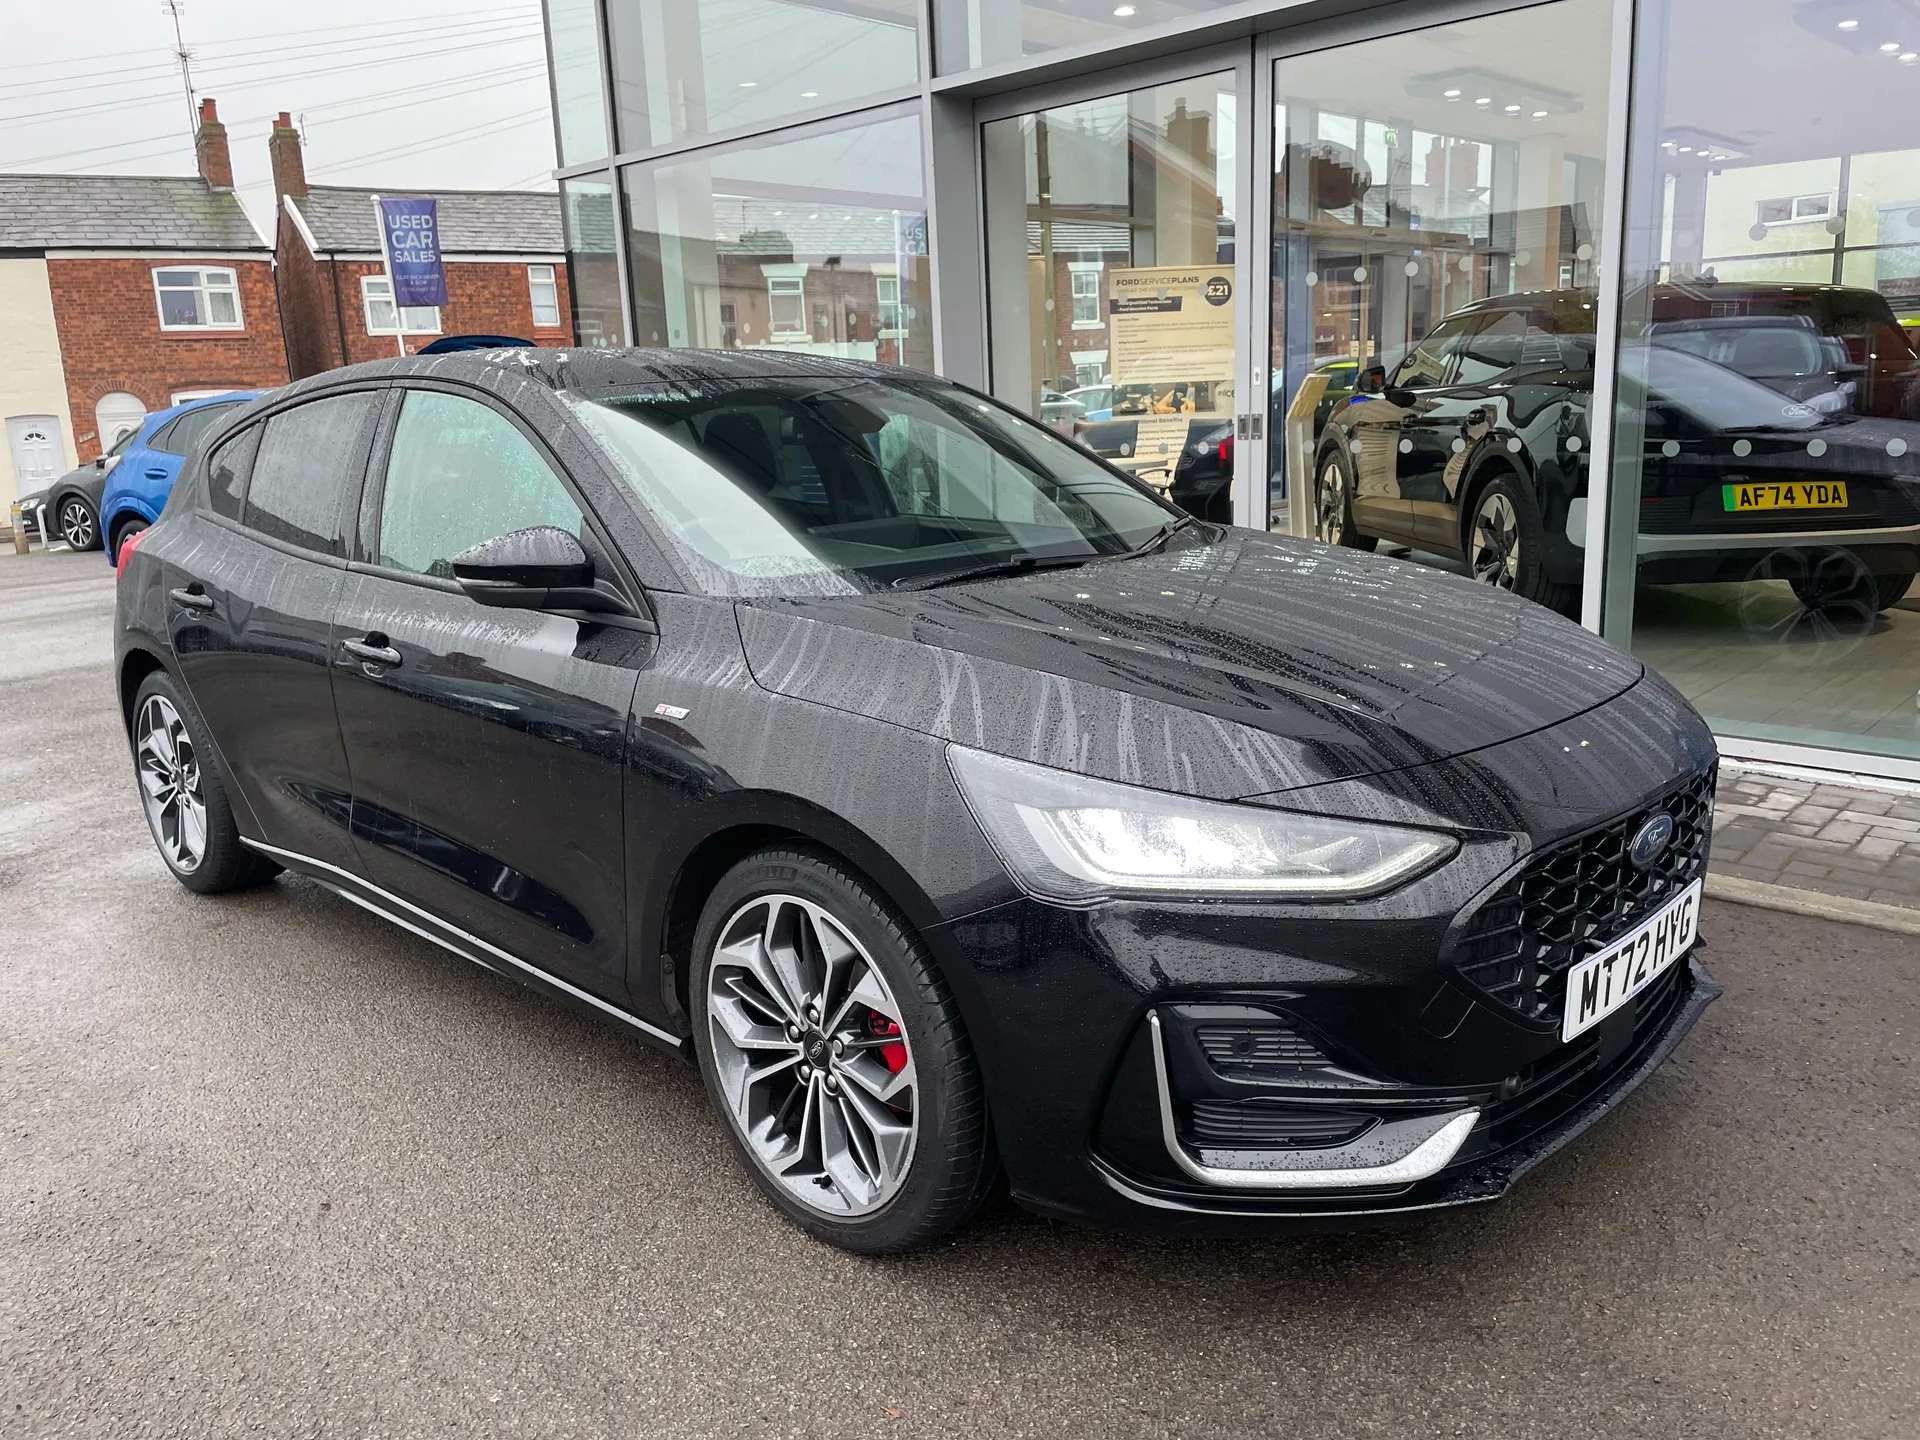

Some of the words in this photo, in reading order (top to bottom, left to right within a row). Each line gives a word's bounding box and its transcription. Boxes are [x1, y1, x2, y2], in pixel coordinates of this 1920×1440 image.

[388, 215, 433, 229] USED
[392, 231, 433, 249] CAR
[395, 250, 436, 263] SALES
[1207, 285, 1229, 296] £21
[1740, 485, 1796, 507] AF74
[1802, 485, 1843, 504] YDA
[1578, 930, 1650, 1024] MT72
[1653, 894, 1693, 970] HYG
